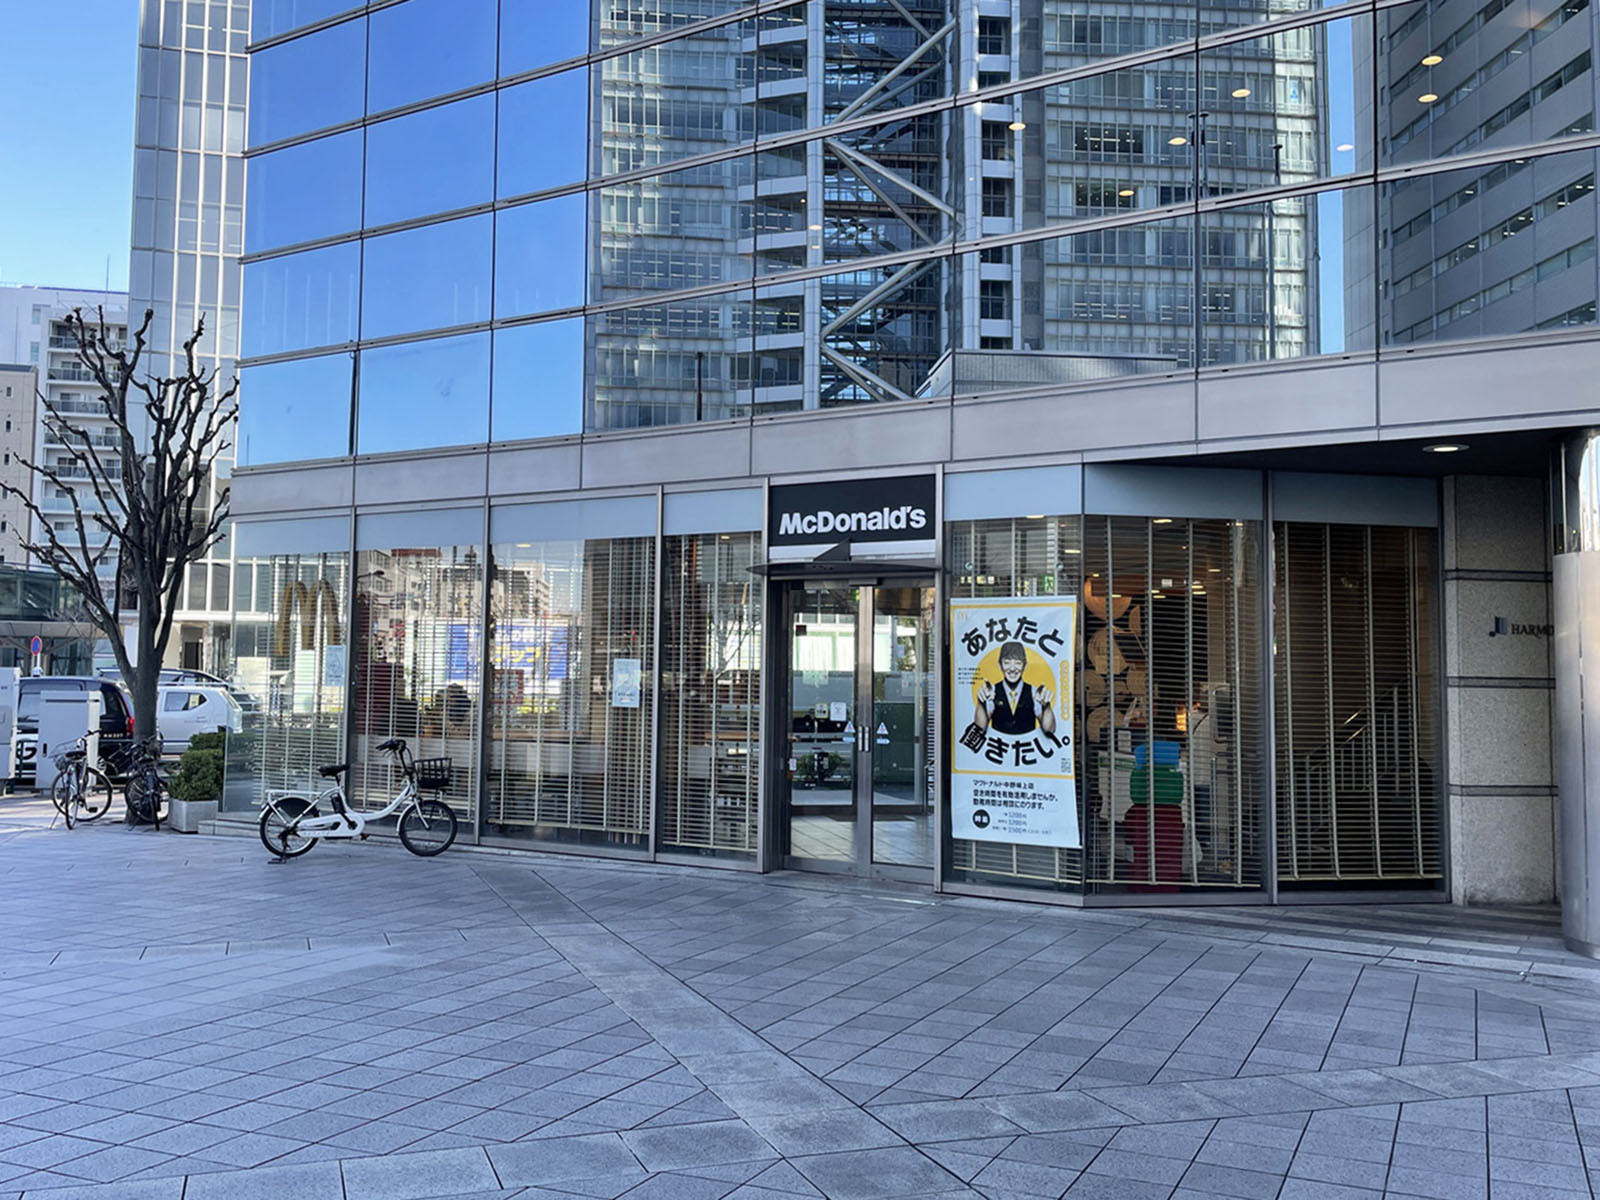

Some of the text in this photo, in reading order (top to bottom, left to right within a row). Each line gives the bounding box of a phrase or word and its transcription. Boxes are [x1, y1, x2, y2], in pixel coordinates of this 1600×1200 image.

[779, 506, 927, 535] McDonald's
[961, 616, 1064, 657] あなたと
[959, 722, 1070, 766] 働きたい。
